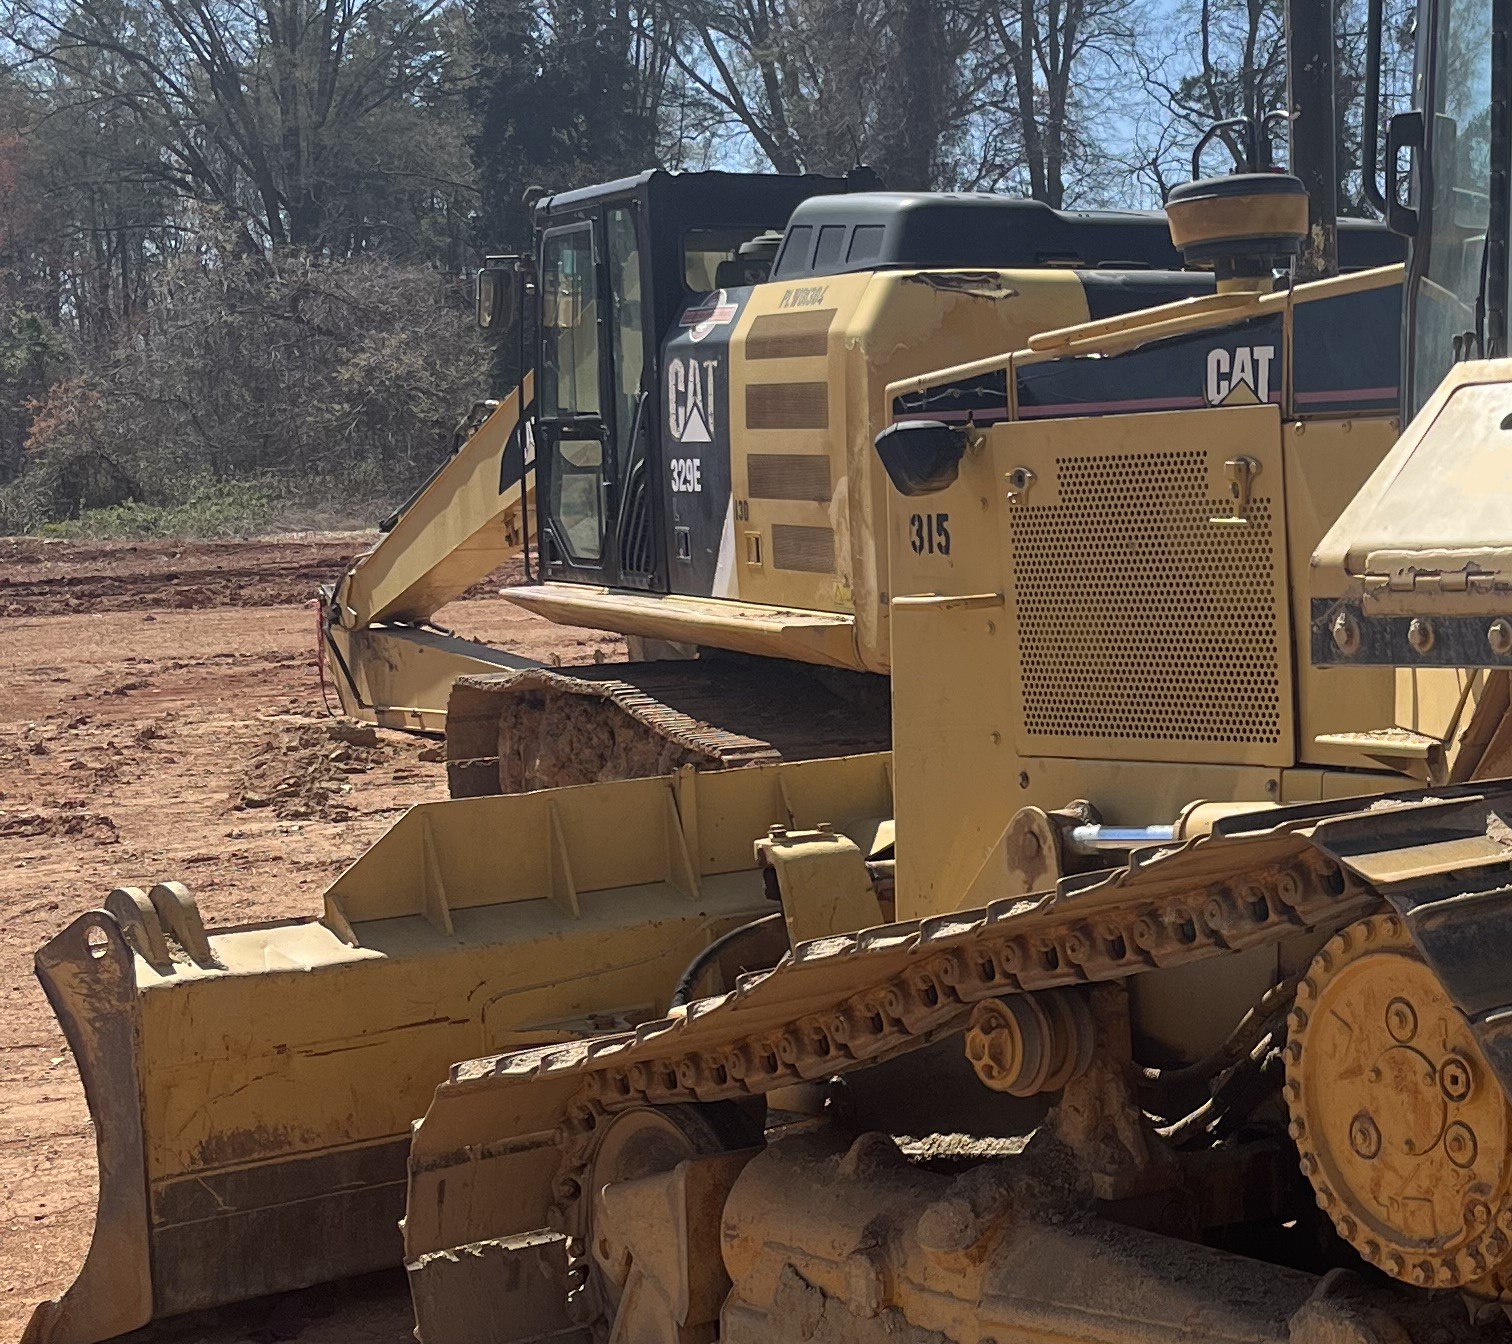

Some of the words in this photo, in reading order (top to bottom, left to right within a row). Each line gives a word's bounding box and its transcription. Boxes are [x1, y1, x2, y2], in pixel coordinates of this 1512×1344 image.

[668, 358, 718, 442] CAT
[1207, 345, 1275, 405] CAT
[671, 458, 702, 493] 329E
[910, 513, 951, 556] 315
